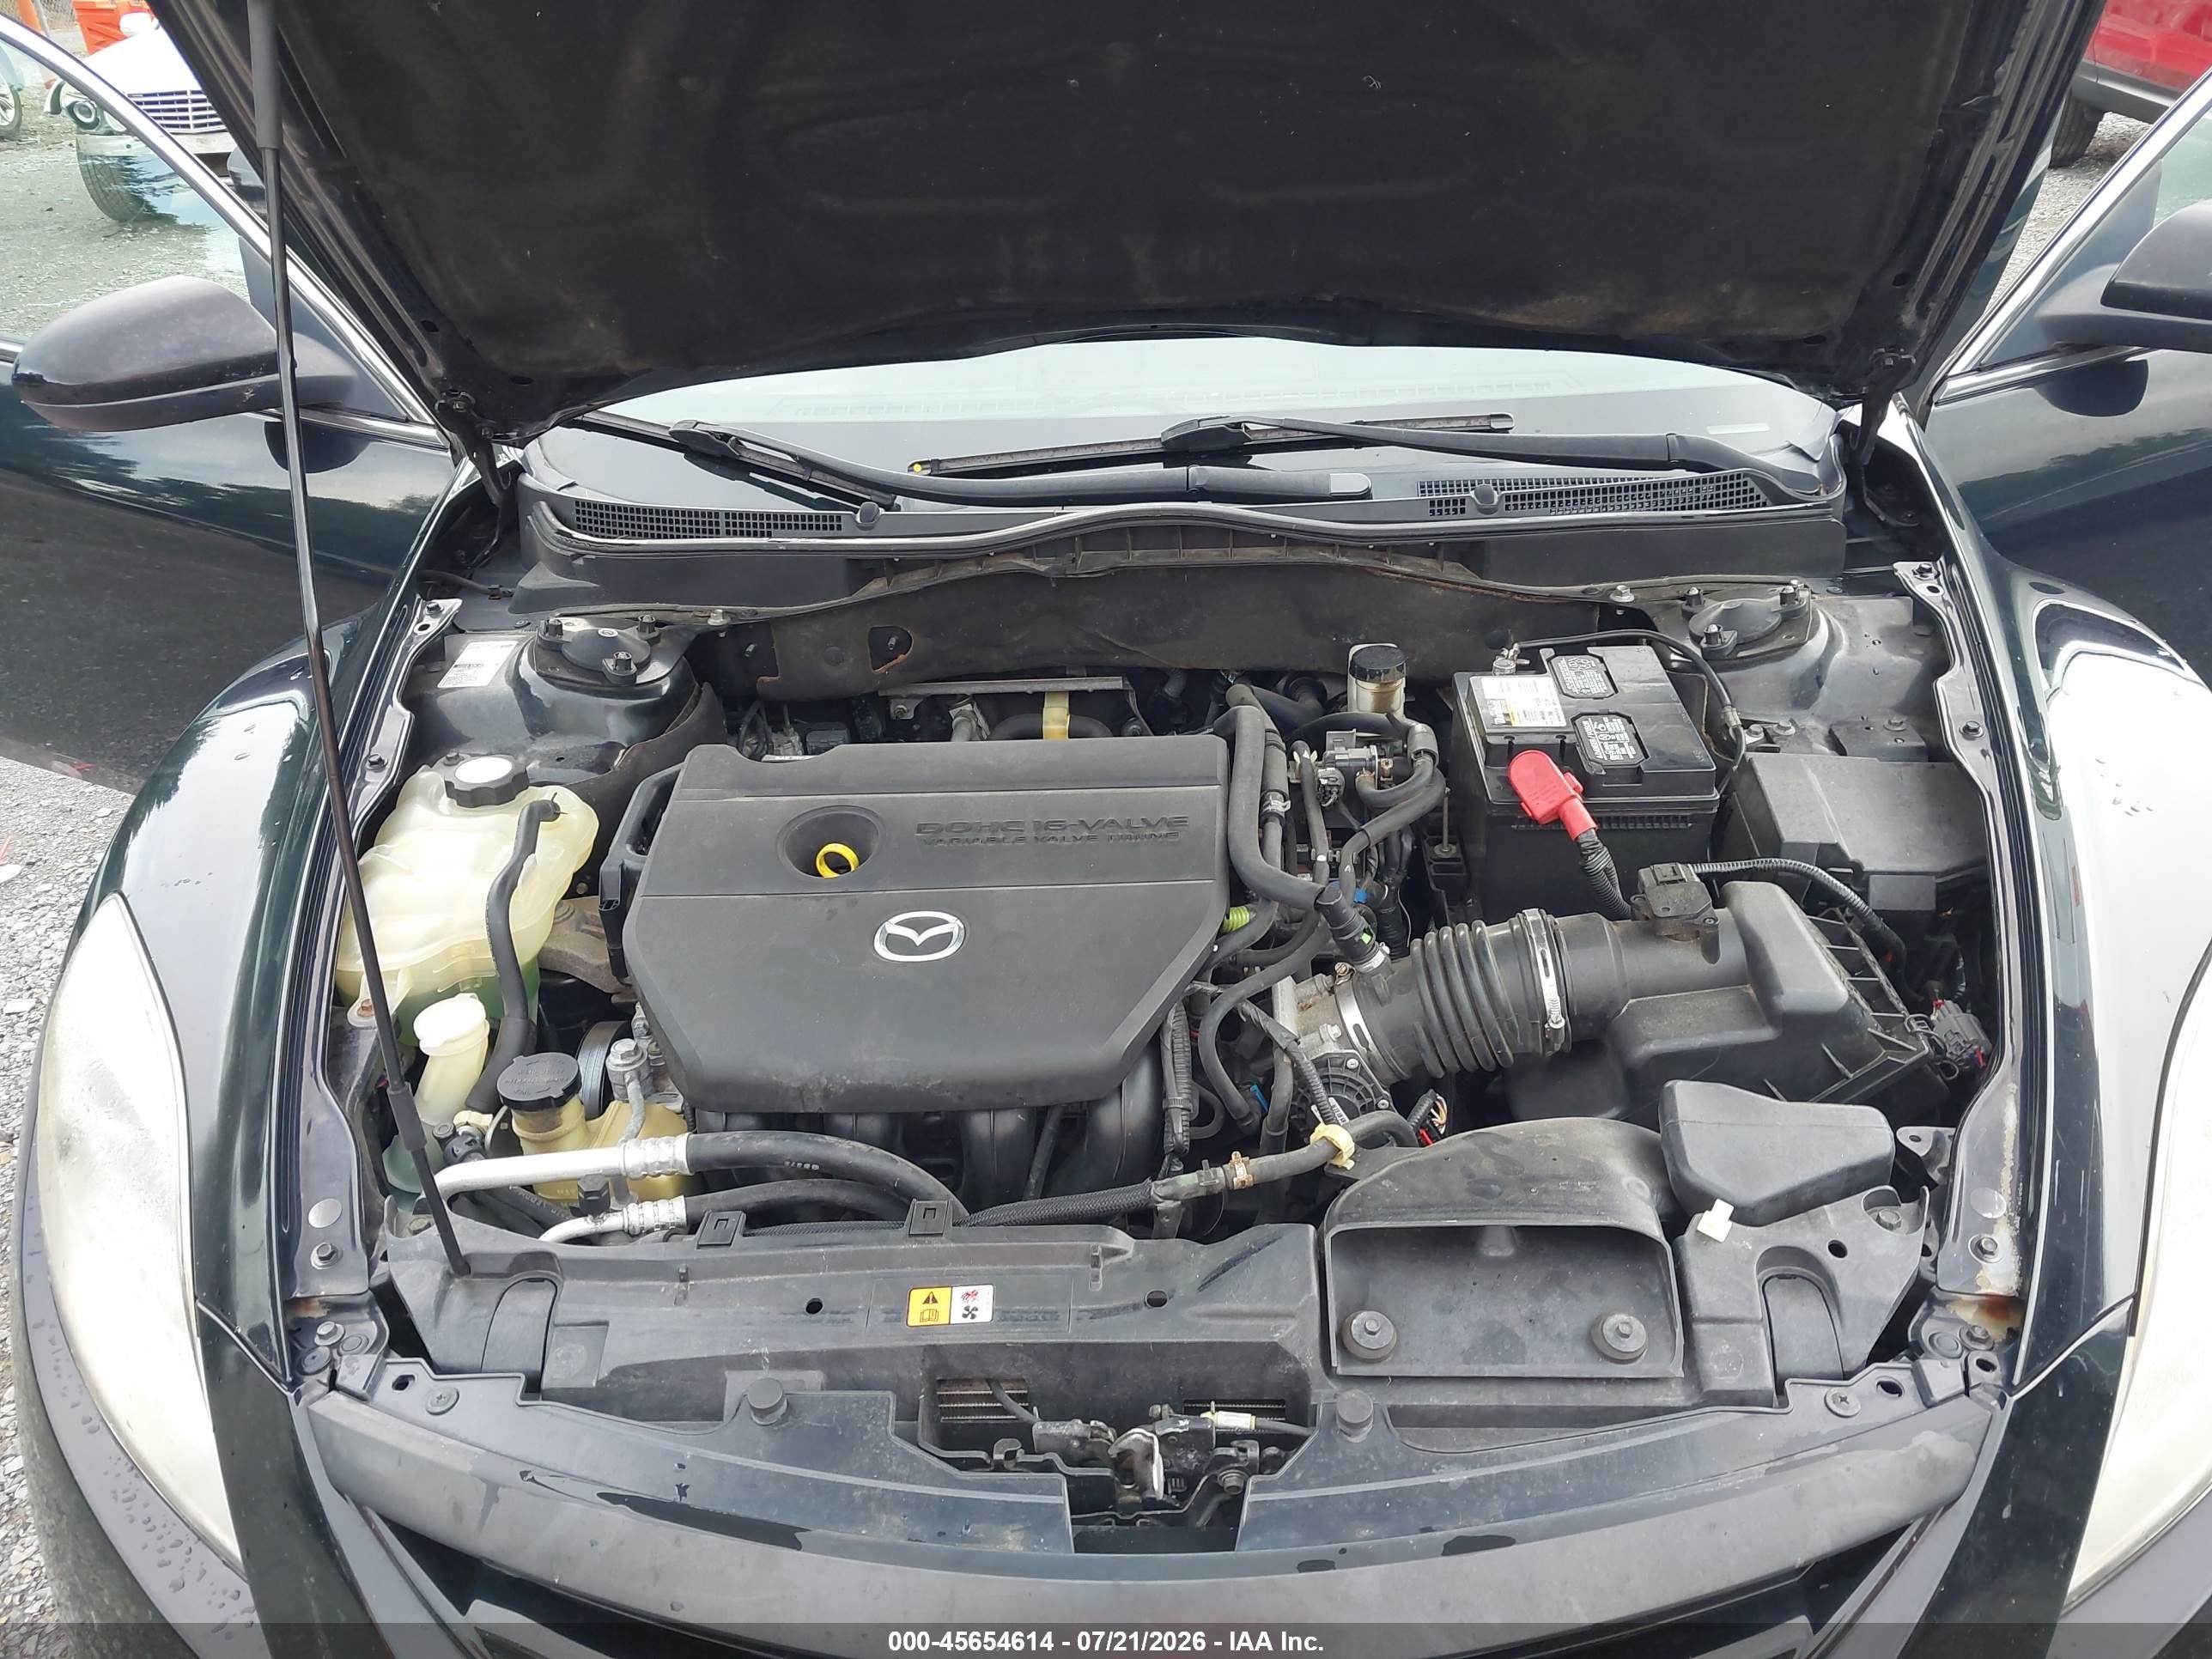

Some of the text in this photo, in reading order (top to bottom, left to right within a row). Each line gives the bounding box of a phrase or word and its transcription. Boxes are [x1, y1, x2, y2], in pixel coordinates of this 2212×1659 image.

[915, 815, 1189, 836] DOHC 16-VALVE
[1034, 834, 1100, 845] VALVE
